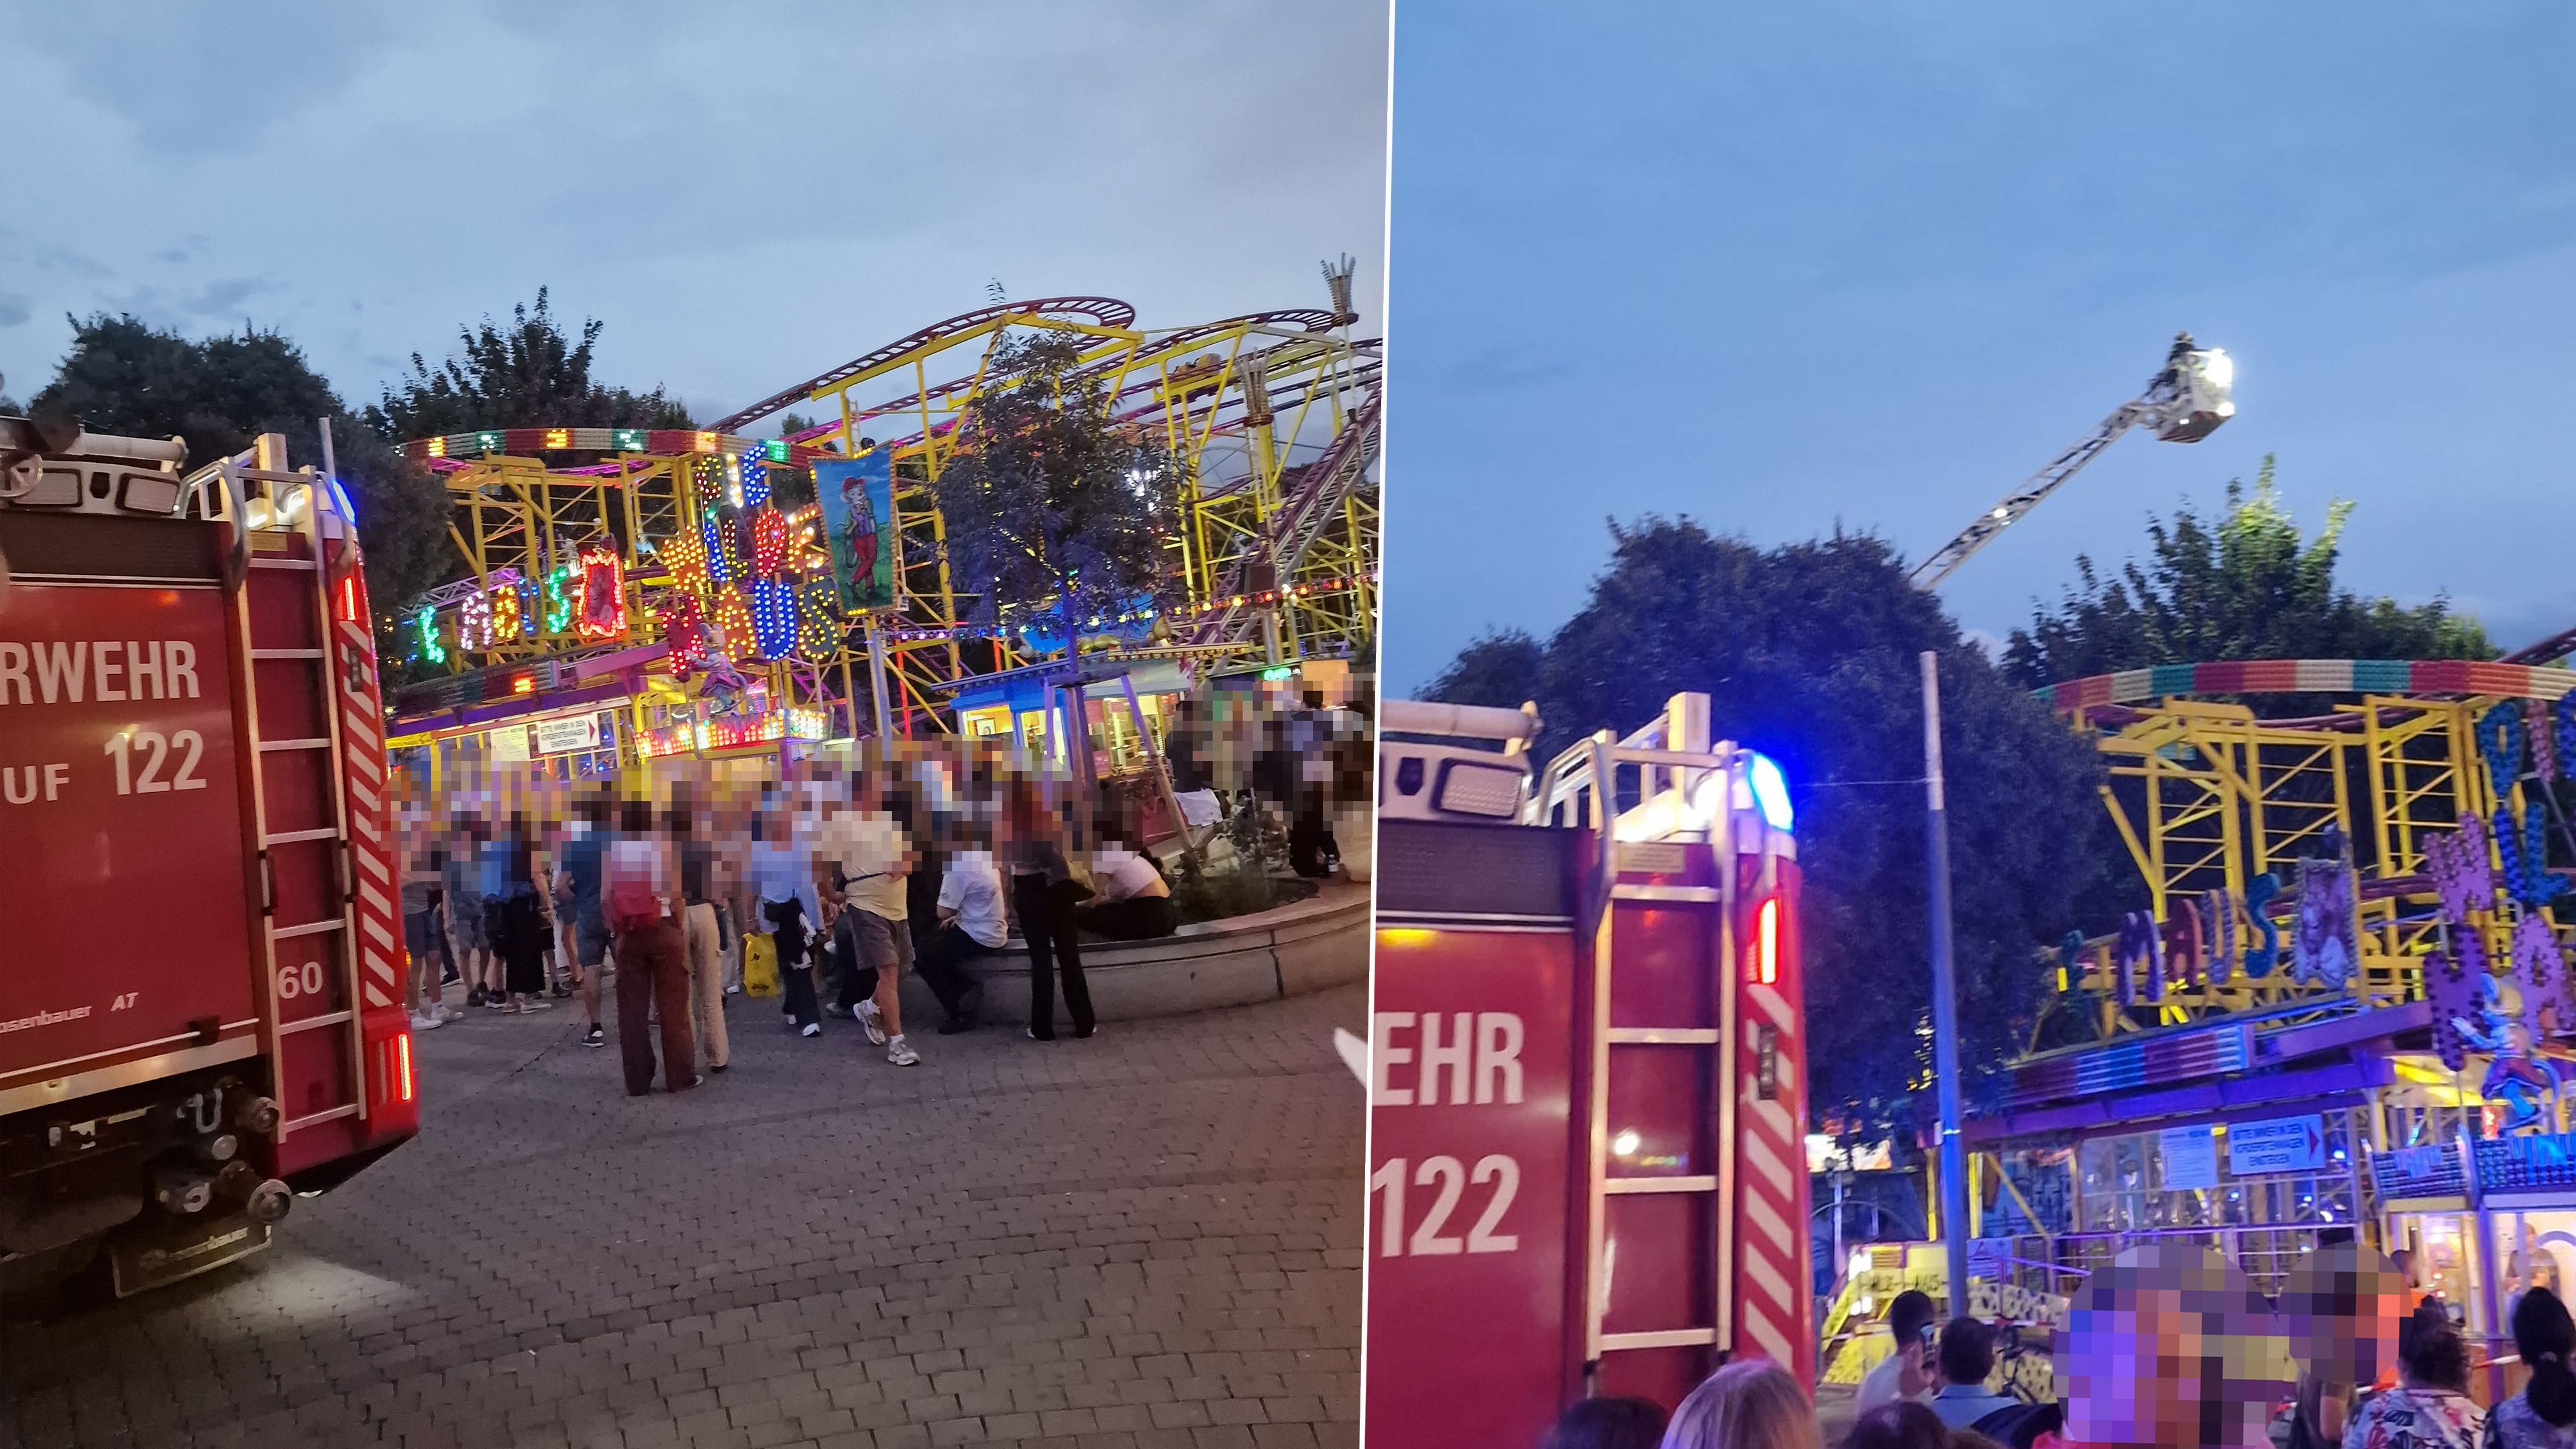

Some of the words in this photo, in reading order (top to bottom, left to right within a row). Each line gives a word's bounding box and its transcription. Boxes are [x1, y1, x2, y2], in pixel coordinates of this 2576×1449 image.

[661, 502, 828, 591] WILDE
[661, 575, 839, 675] MAUS
[0, 641, 201, 704] RWEHR
[3, 763, 70, 804] UF
[104, 730, 207, 796] 122
[2422, 802, 2576, 924] WIL
[278, 961, 323, 1000] 60
[2116, 873, 2280, 1006] MAUS
[111, 992, 139, 1011] AT
[1372, 1012, 1524, 1106] EHR
[1371, 1155, 1520, 1258] 122
